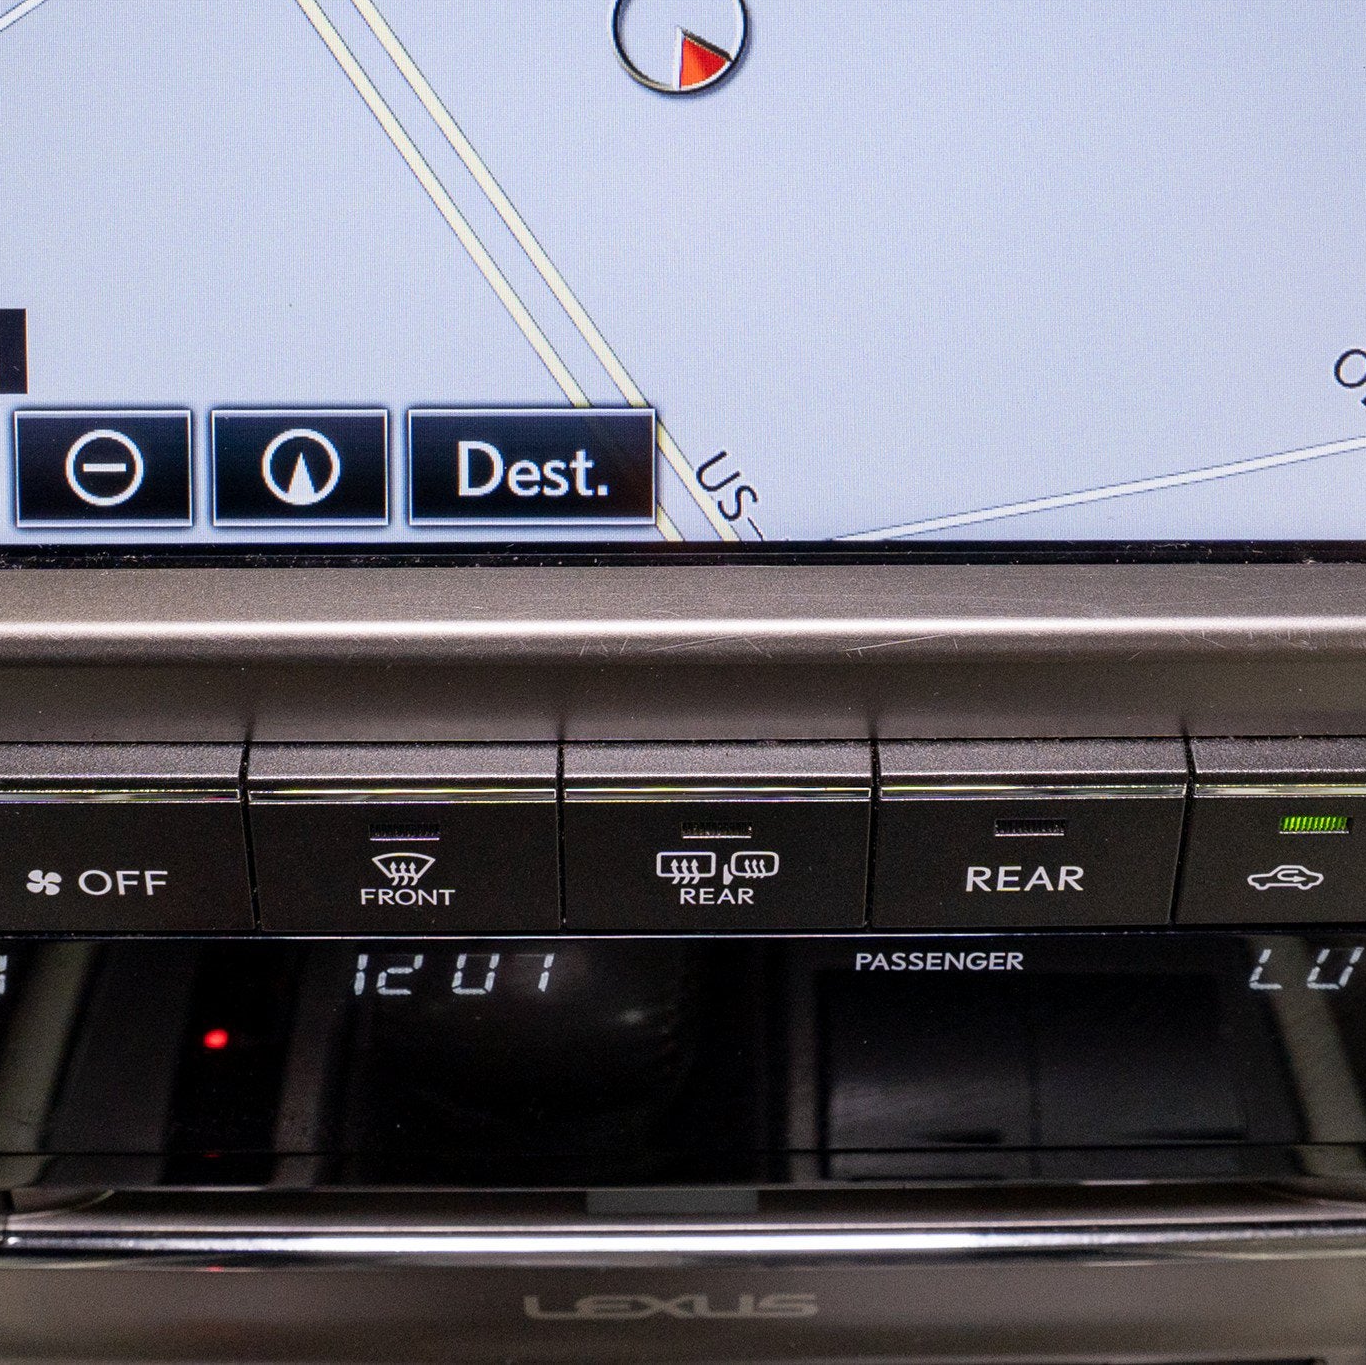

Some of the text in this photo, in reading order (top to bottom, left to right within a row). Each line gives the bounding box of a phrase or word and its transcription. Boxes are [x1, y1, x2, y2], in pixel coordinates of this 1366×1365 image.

[458, 441, 607, 496] Dest.
[78, 870, 168, 895] OFF
[966, 866, 1084, 891] REAR
[361, 889, 455, 906] FRONT
[680, 888, 754, 905] REAR
[856, 952, 1023, 970] PASSENGER
[525, 1294, 820, 1320] LEXUS
